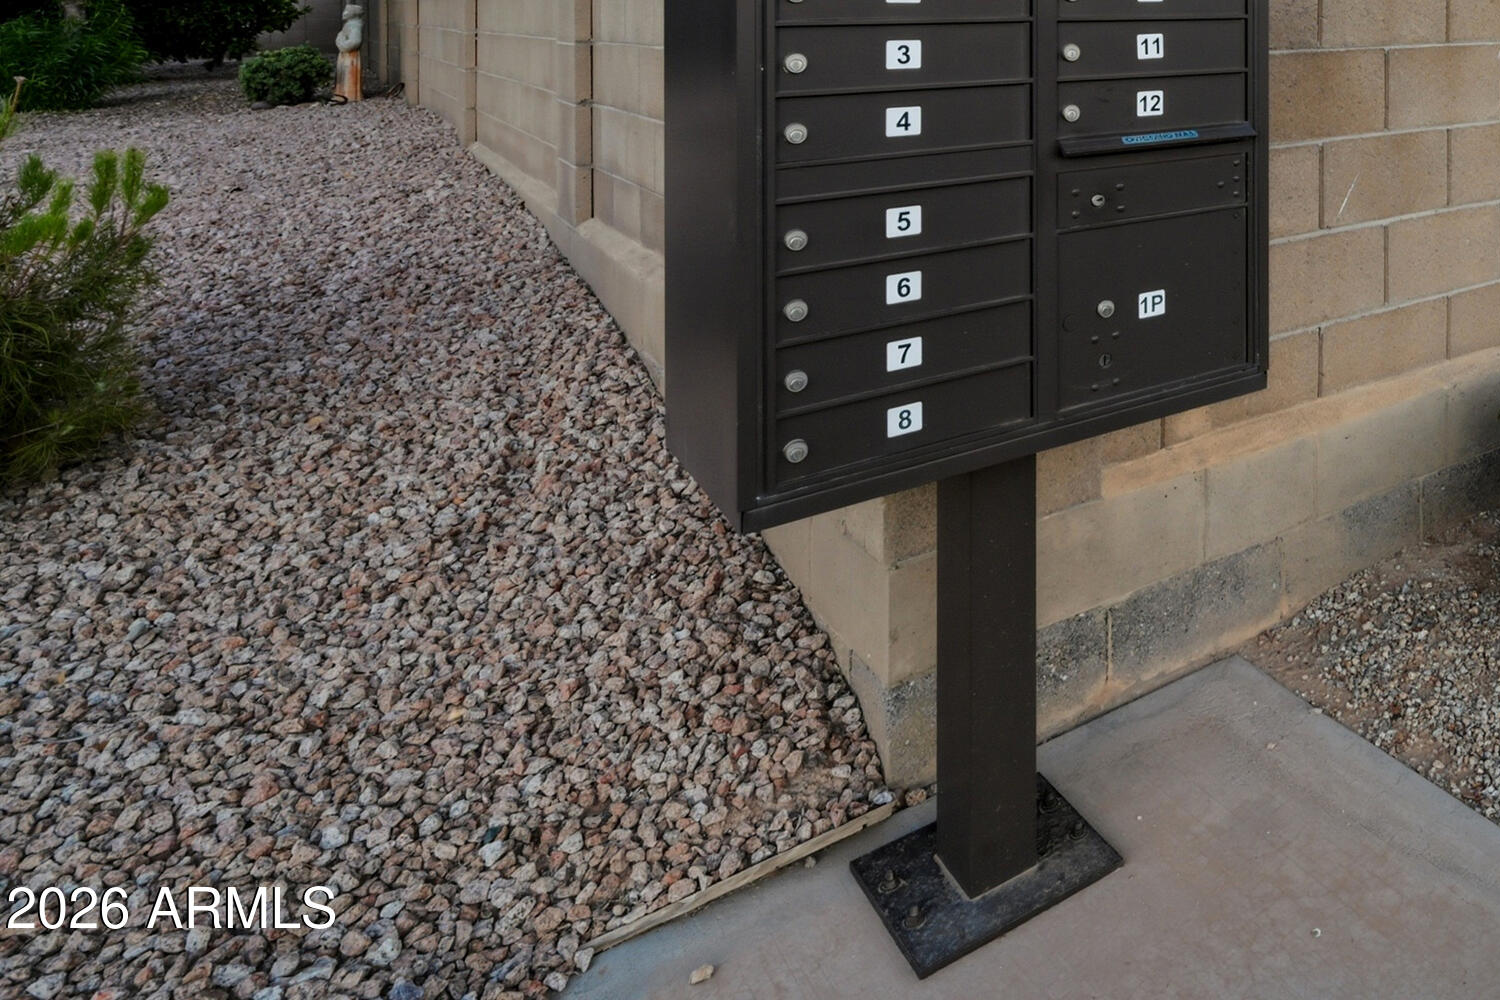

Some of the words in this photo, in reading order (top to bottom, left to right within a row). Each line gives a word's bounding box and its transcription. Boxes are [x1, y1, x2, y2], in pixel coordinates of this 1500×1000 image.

[897, 44, 911, 65] 3
[1140, 37, 1160, 56] 11
[1139, 94, 1161, 113] 12
[896, 111, 912, 132] 4
[897, 210, 911, 232] 5
[897, 277, 911, 298] 6
[1140, 294, 1164, 314] 1P
[897, 342, 912, 364] 7
[898, 409, 912, 430] 8
